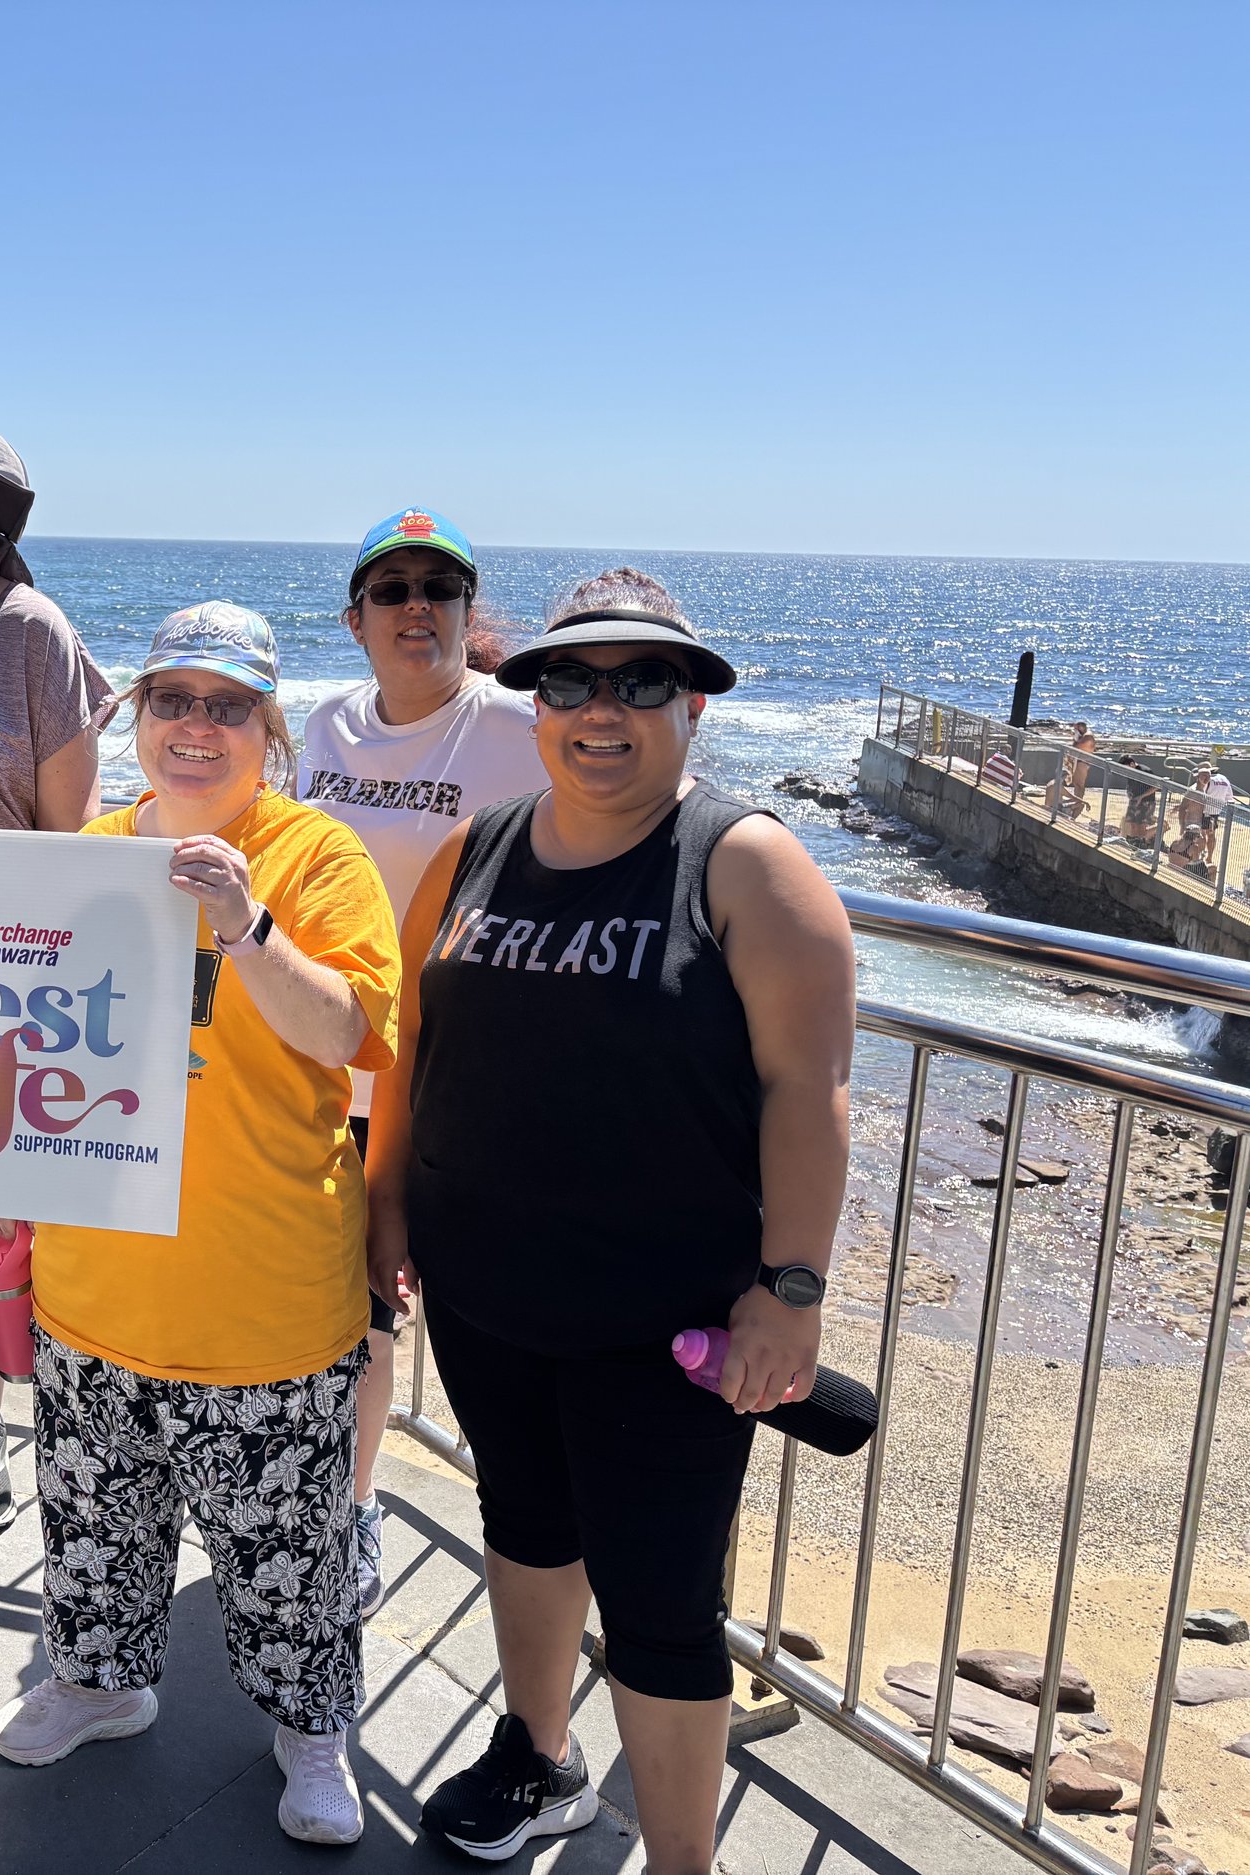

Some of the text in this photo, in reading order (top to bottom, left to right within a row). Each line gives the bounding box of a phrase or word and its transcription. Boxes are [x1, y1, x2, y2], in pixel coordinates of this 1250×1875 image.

[164, 621, 252, 648] Awesome
[303, 770, 462, 818] WARRIOR
[437, 905, 662, 980] VERLAST
[187, 1071, 203, 1080] OPE
[13, 1134, 159, 1164] SUPPORT PROGRAM
